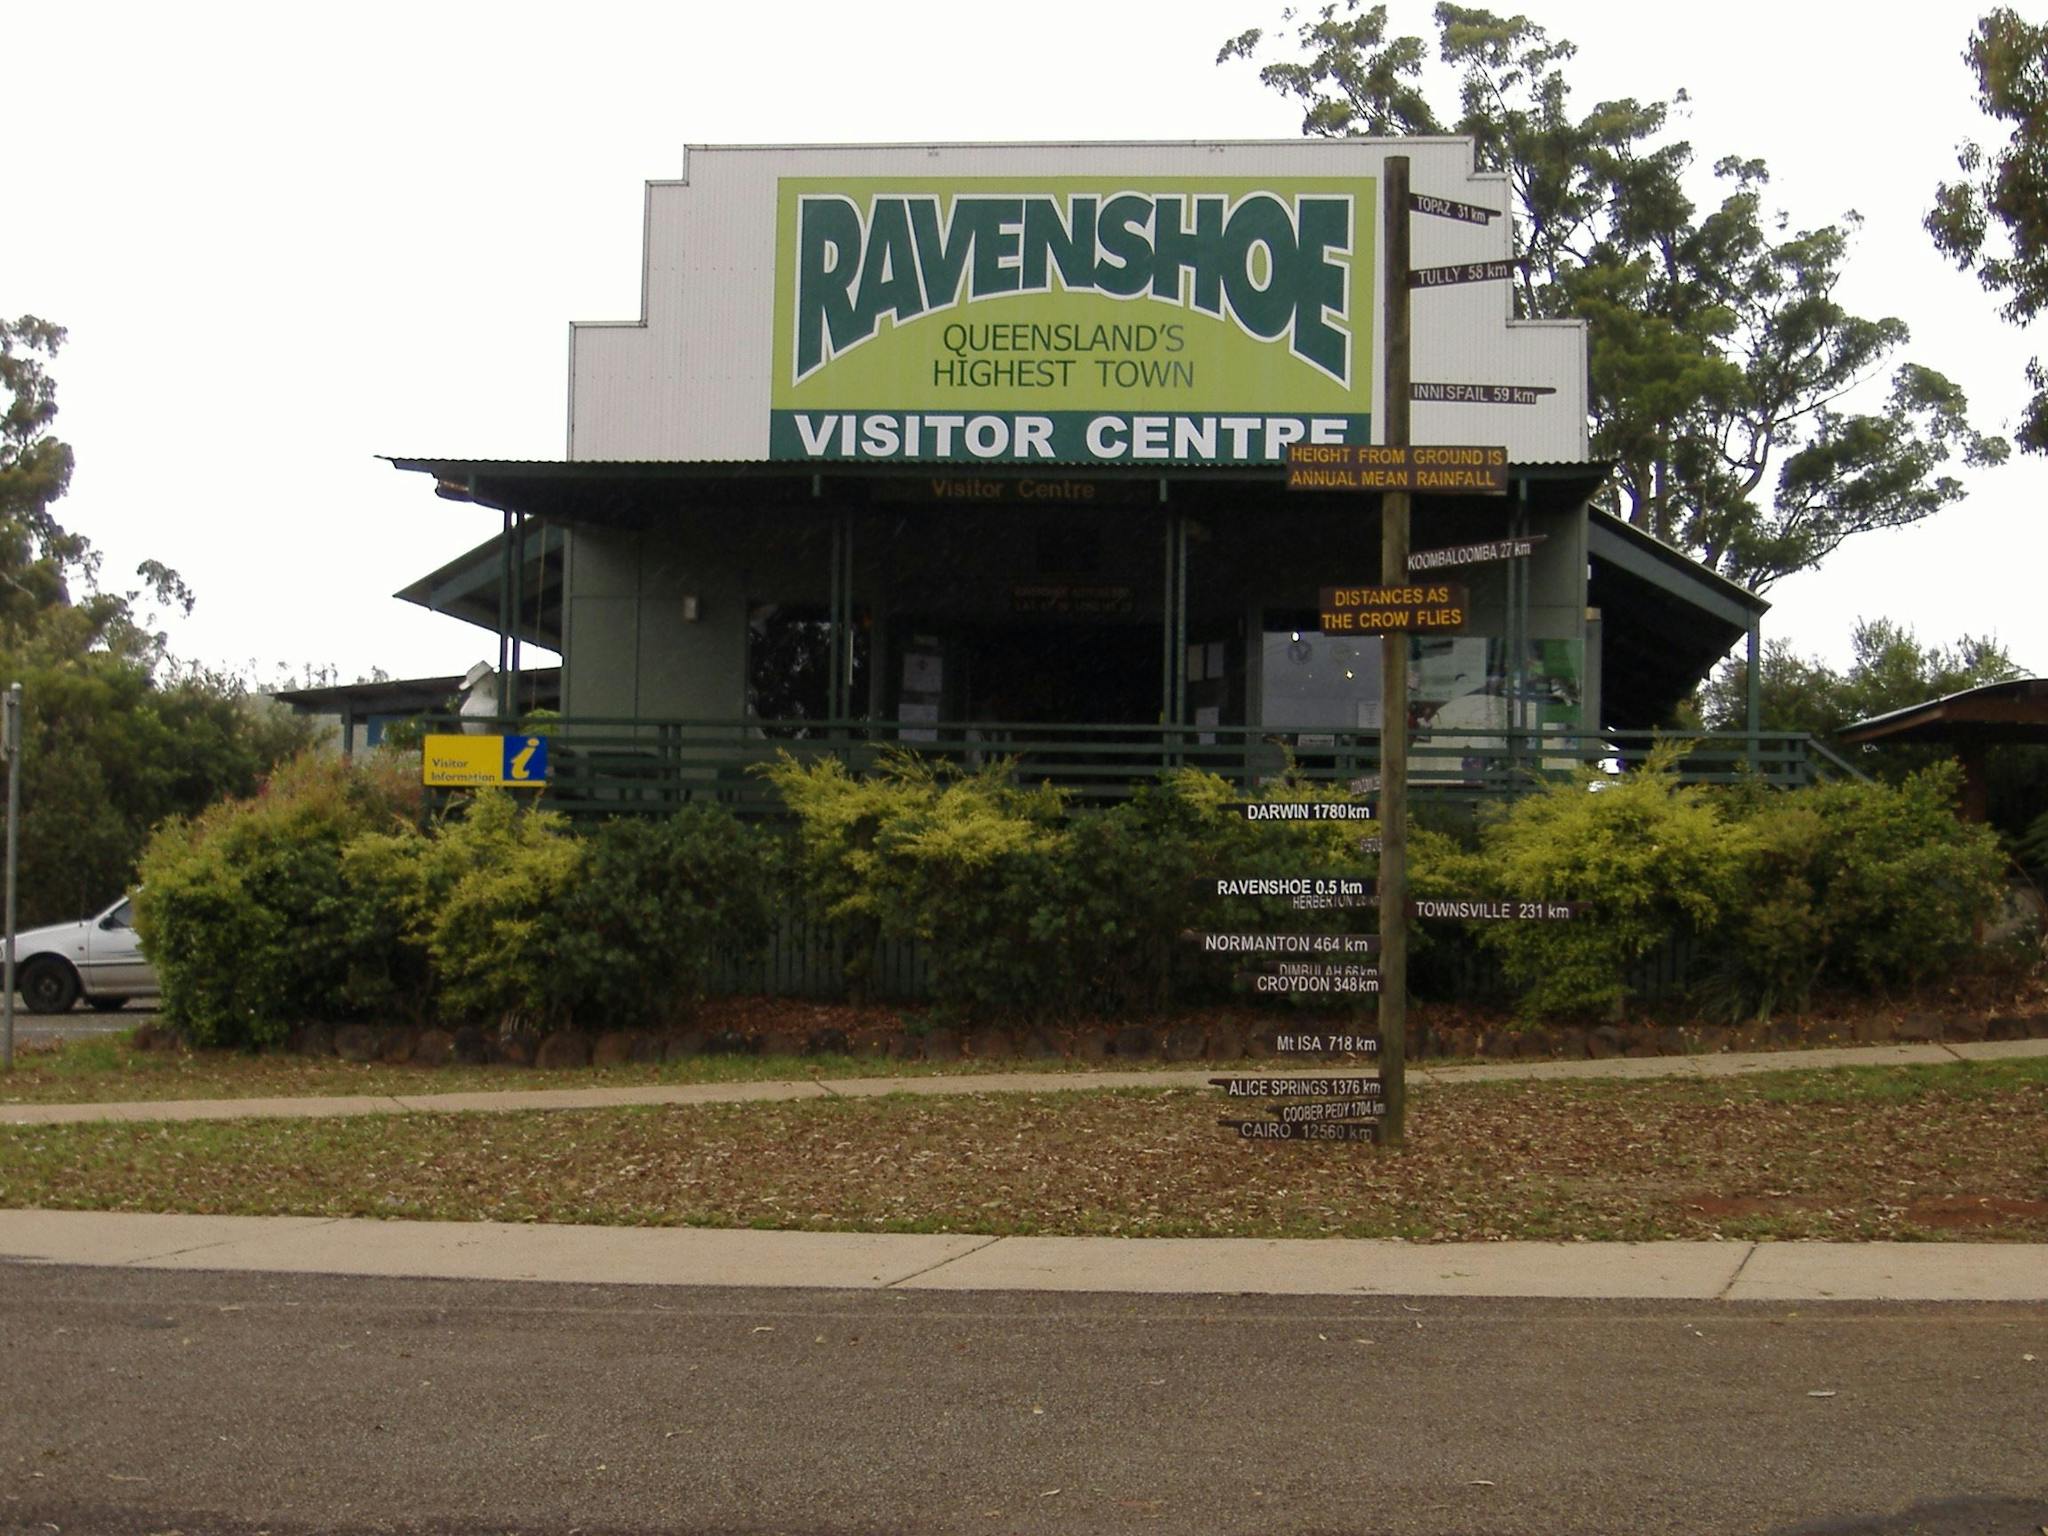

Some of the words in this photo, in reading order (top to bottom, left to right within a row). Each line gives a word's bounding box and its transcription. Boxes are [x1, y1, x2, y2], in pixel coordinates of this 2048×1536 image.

[1417, 197, 1451, 216] TOPAZ
[1457, 204, 1469, 218] 31
[1471, 207, 1486, 222] km
[1419, 267, 1461, 285] TULLY
[1468, 265, 1483, 280] 58
[1487, 264, 1508, 279] km
[792, 190, 1355, 392] RAVENSHOE
[943, 324, 1185, 357] QUEENSLAND'S
[933, 360, 1076, 388] HIGHEST
[1100, 360, 1194, 388] TOWN
[1414, 384, 1488, 401] INNISFAIL
[1494, 387, 1510, 402] 59
[1514, 388, 1536, 403] km
[794, 414, 1054, 459] VISITOR
[1291, 447, 1351, 463] HEIGHT
[1359, 448, 1405, 464] FROM
[1414, 449, 1483, 465] GROUND
[1488, 450, 1503, 465] IS
[1291, 471, 1356, 486] ANNUAL
[1361, 471, 1408, 486] MEAN
[1416, 471, 1495, 486] RAINFALL
[932, 479, 1004, 498] Visitor
[1018, 479, 1096, 498] Centre
[1408, 544, 1497, 570] KOOMBALOOMBA
[1500, 543, 1512, 558] 27
[1514, 542, 1531, 556] km
[1335, 588, 1423, 606] DISTANCES
[1426, 587, 1448, 602] AS
[1322, 613, 1352, 630] THE
[1359, 611, 1408, 627] CROW
[1417, 609, 1462, 625] FLIES
[432, 758, 468, 768] Visitor
[431, 771, 495, 782] Information
[1247, 804, 1309, 820] DARWIN
[1218, 879, 1311, 895] RAVENSHOE
[1316, 880, 1337, 895] 0.5
[1341, 880, 1363, 895] km
[1416, 902, 1510, 919] TOWNSVILLE
[1519, 903, 1543, 919] 231
[1548, 903, 1569, 919] km
[1205, 935, 1310, 951] NORMANTON
[1314, 936, 1340, 951] 464
[1345, 937, 1368, 951] km
[1257, 976, 1330, 992] CROYDON
[1277, 1035, 1294, 1051] Mt
[1298, 1036, 1321, 1051] ISA
[1329, 1036, 1352, 1051] 718
[1356, 1036, 1377, 1051] km
[1229, 1080, 1267, 1096] ALICE
[1271, 1080, 1328, 1096] SPRINGS
[1332, 1080, 1360, 1095] 1376
[1363, 1080, 1381, 1094] km
[1283, 1104, 1323, 1122] COOBER
[1325, 1103, 1350, 1119] PEDY
[1241, 1122, 1292, 1139] CAIRO
[1303, 1124, 1345, 1140] 12560
[1349, 1126, 1373, 1140] km
